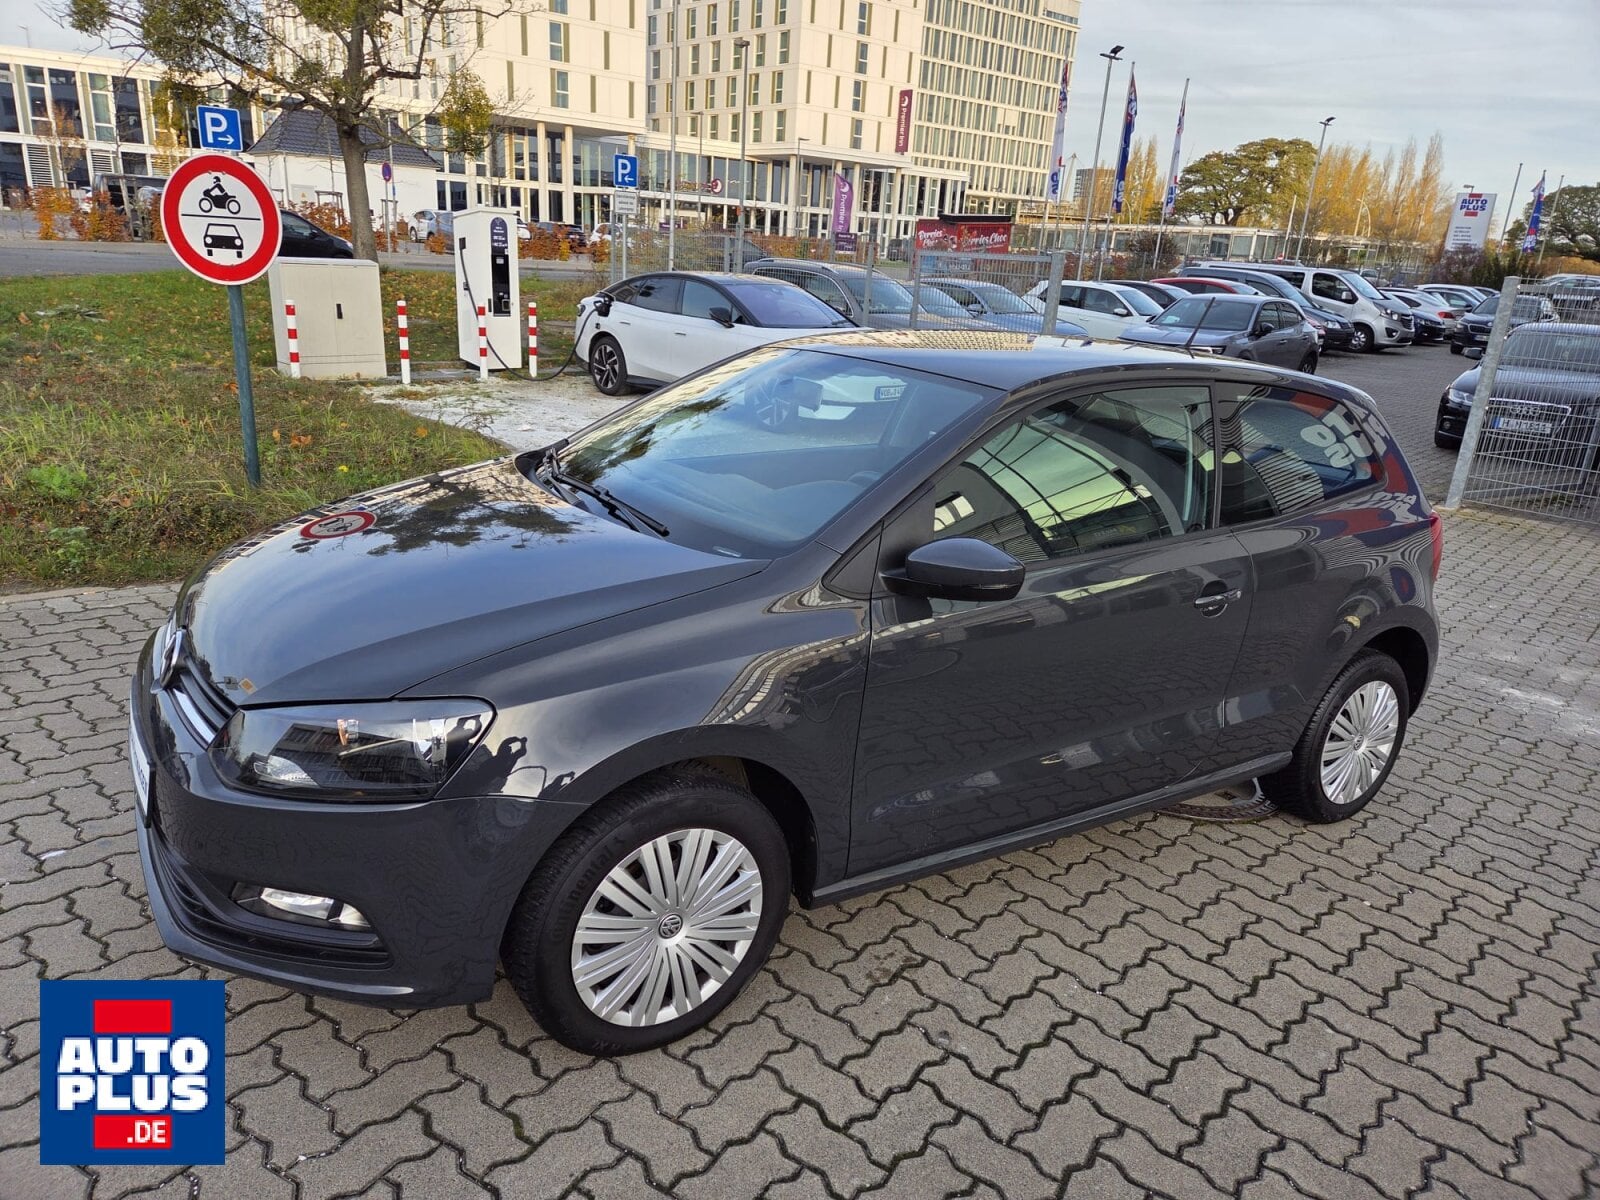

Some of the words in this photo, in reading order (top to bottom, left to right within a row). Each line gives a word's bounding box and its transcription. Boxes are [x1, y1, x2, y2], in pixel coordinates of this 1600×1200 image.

[203, 112, 228, 144] P
[899, 107, 908, 135] Premier
[617, 158, 632, 183] P
[839, 194, 848, 224] Premier
[1459, 204, 1487, 212] PLUS
